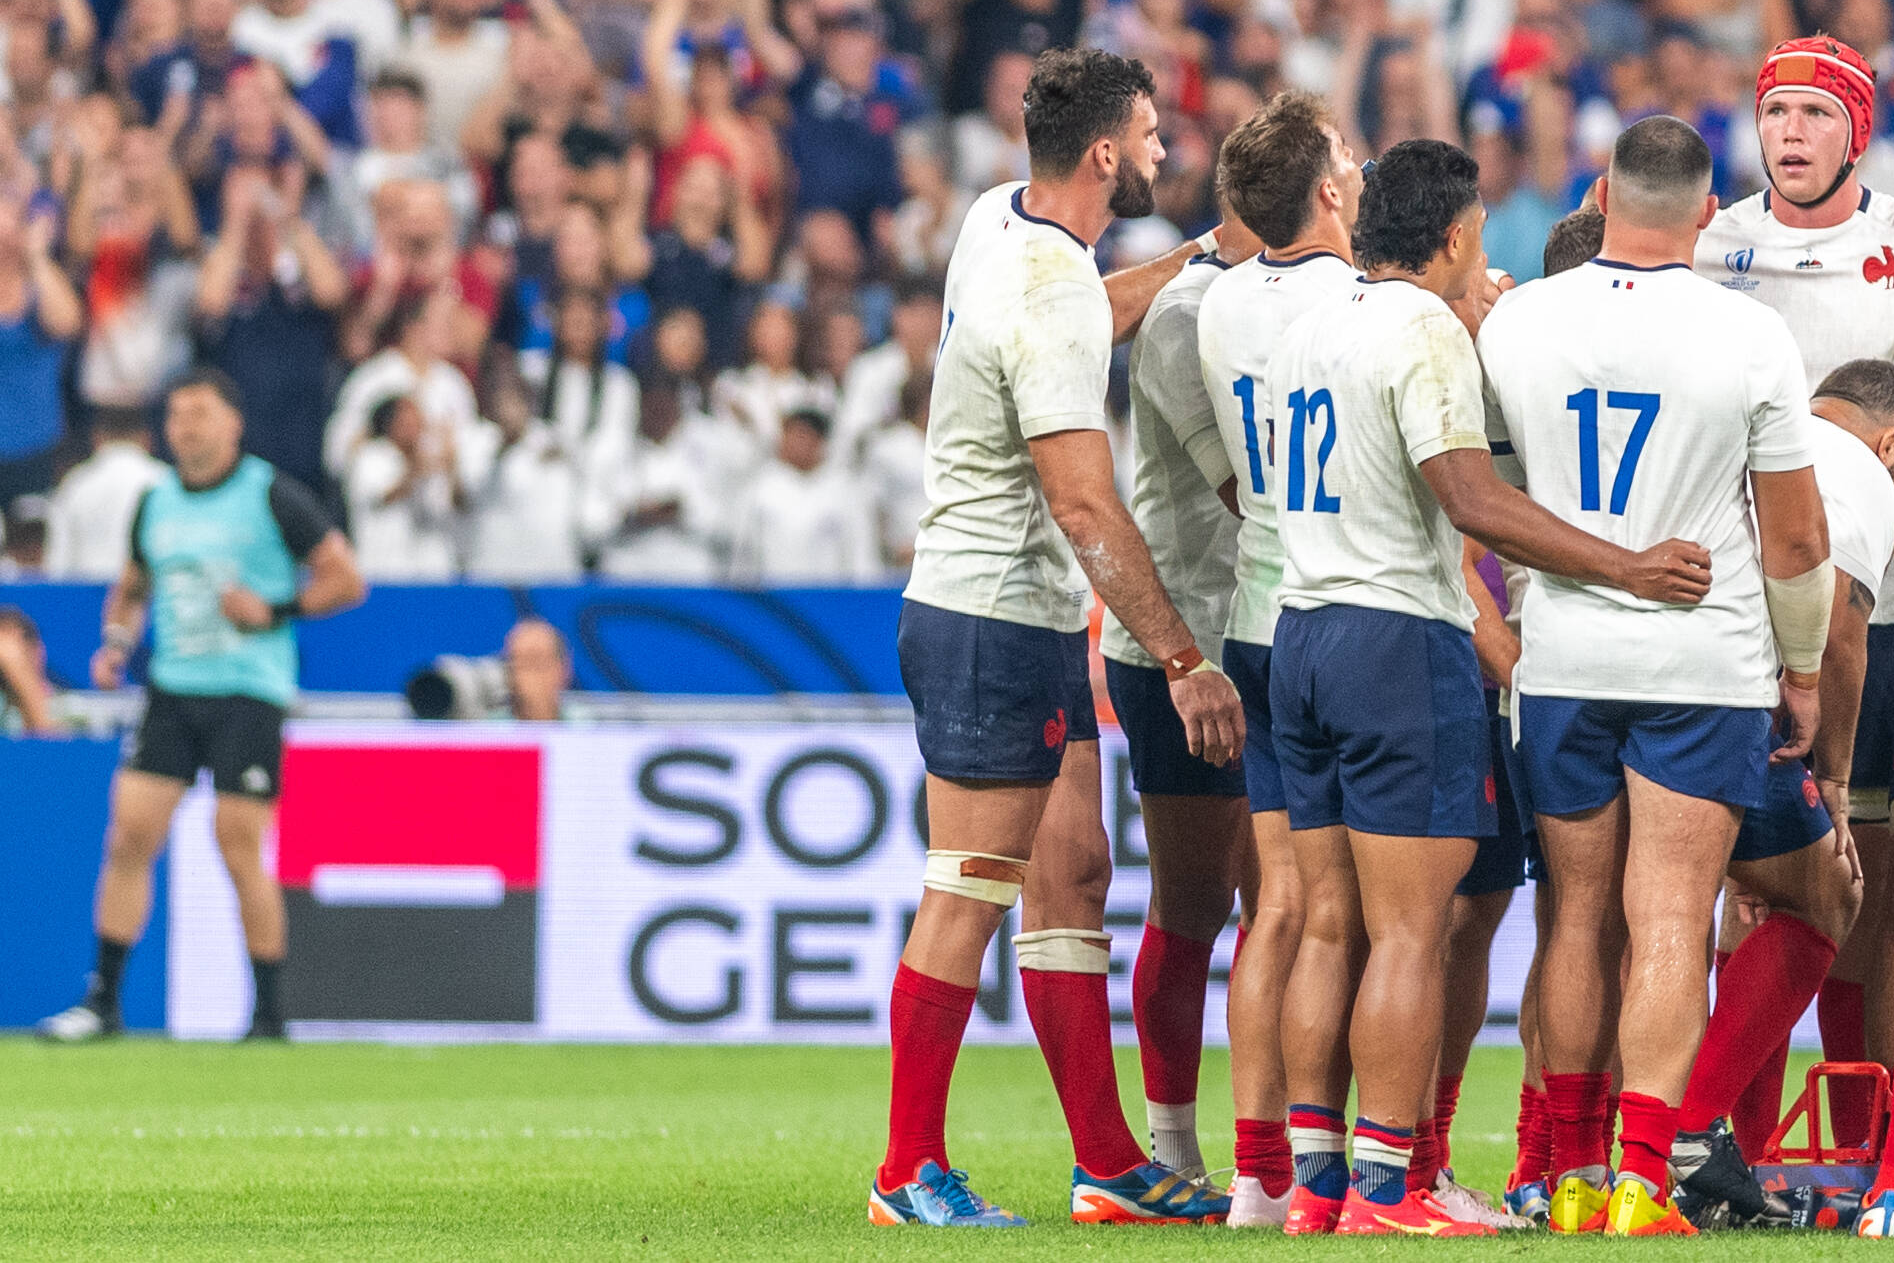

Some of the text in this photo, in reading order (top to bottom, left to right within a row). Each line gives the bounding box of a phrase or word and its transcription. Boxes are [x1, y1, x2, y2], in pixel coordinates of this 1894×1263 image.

[1233, 375, 1266, 494] 1
[1287, 386, 1341, 514] 12
[1567, 387, 1661, 516] 17
